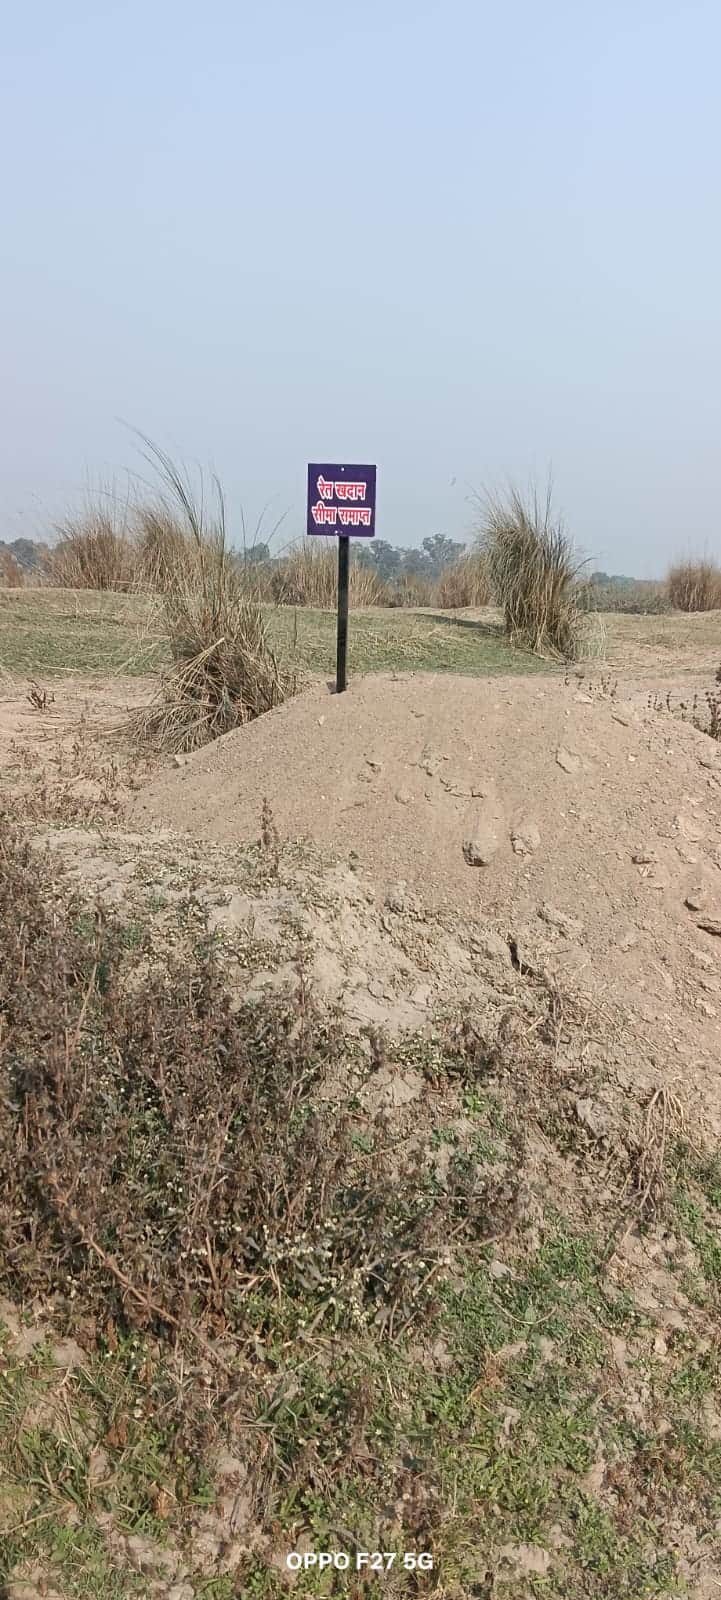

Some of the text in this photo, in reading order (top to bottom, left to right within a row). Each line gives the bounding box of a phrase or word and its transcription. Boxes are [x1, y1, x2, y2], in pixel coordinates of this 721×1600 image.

[317, 475, 367, 501] रेत खदान
[312, 501, 371, 526] सीमा समाप्त
